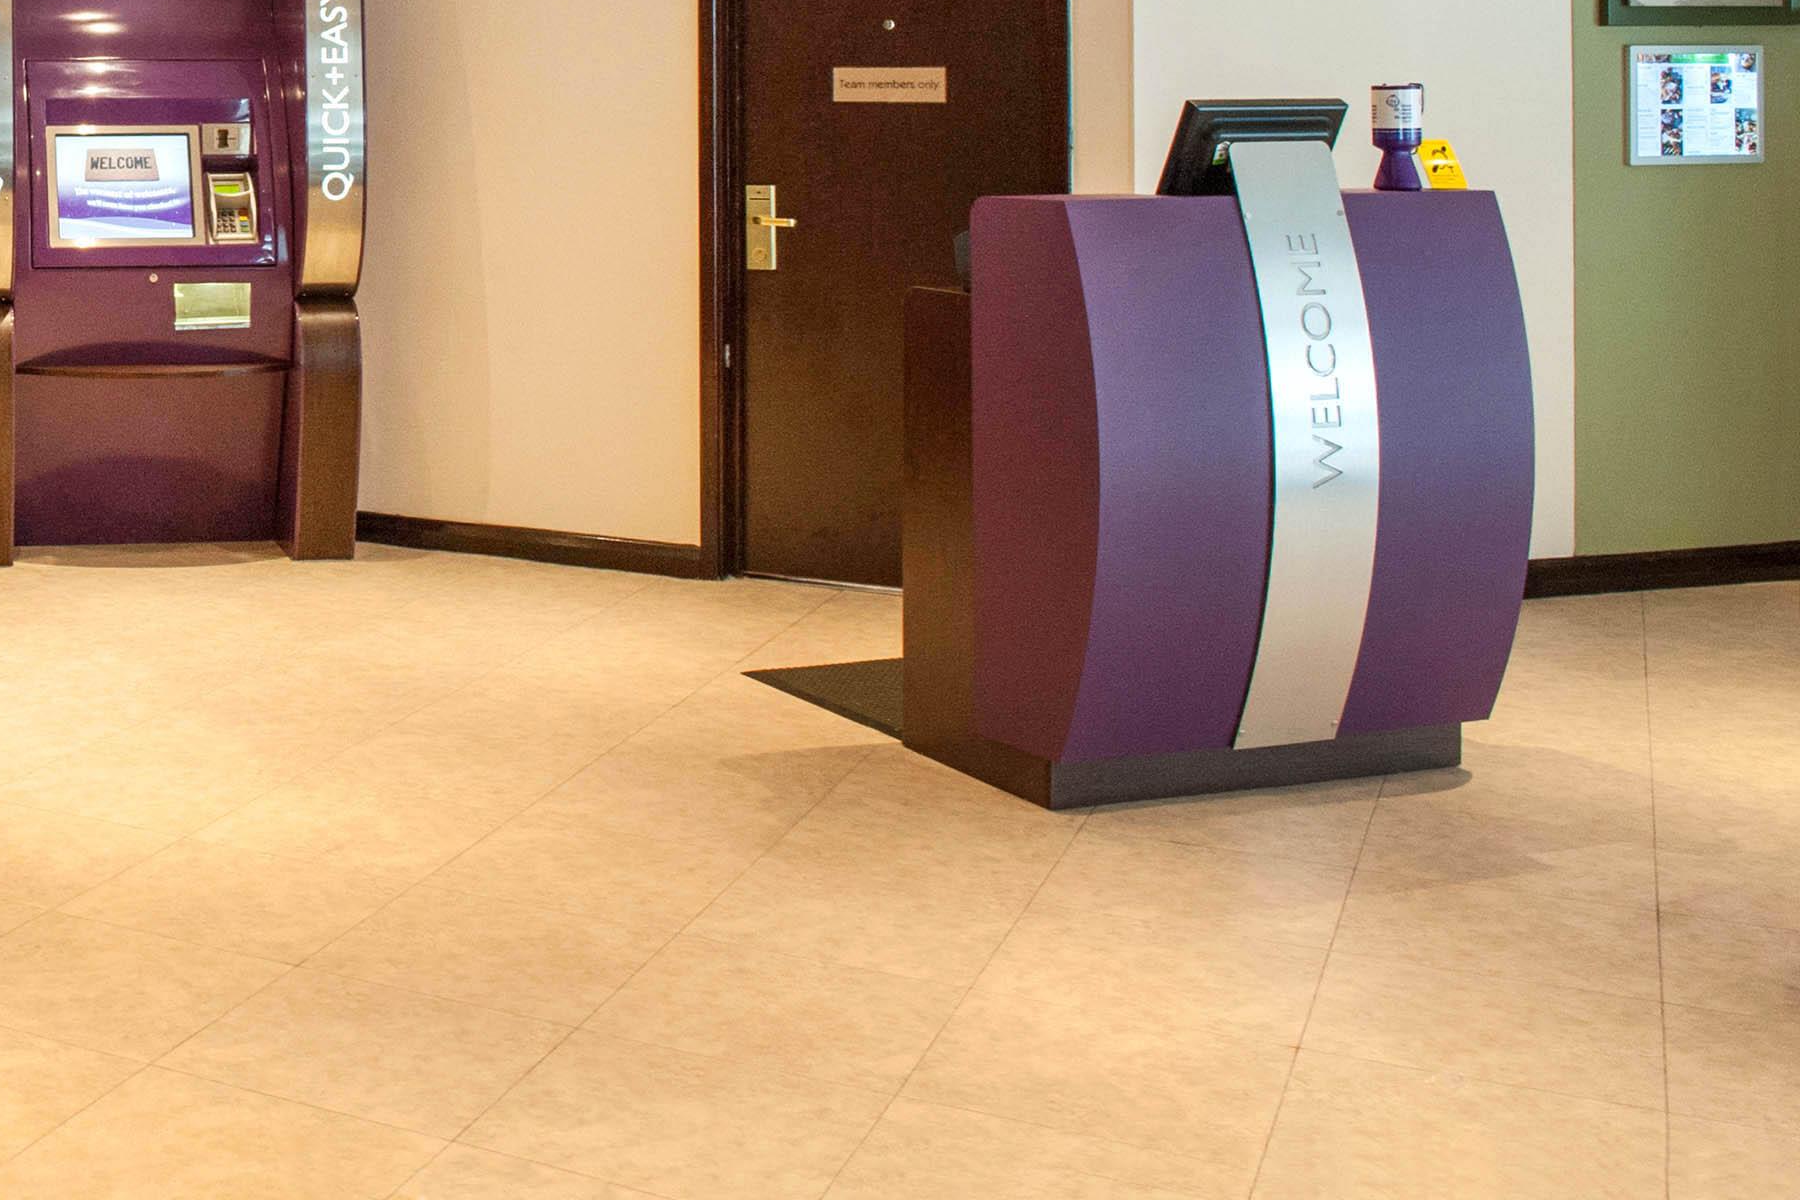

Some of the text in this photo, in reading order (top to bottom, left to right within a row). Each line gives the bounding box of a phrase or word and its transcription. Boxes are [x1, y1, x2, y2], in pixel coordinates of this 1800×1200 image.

[839, 79, 939, 91] Team members only
[89, 156, 152, 170] WELCOME
[1284, 232, 1344, 490] WELCOME
